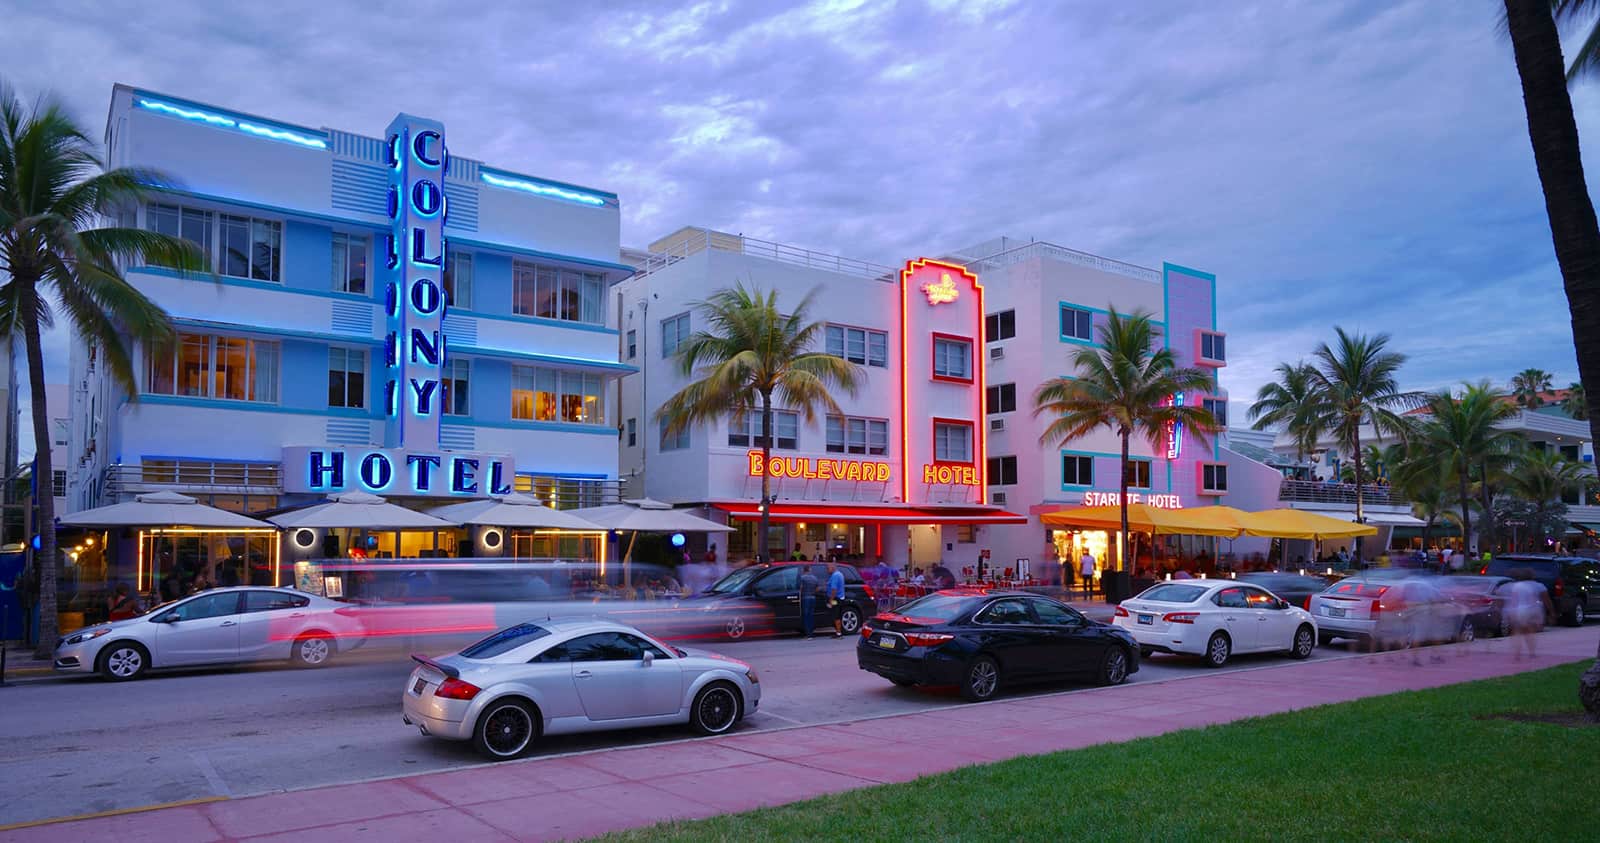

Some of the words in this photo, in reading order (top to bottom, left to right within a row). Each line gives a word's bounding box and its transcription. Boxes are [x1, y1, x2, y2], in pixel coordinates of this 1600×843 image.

[410, 130, 441, 415] COLONY
[310, 451, 511, 495] HOTEL
[748, 450, 891, 482] BOULEVARD
[923, 463, 981, 486] HOTEL
[1084, 491, 1141, 507] STARLTE
[1147, 494, 1183, 510] HOTEL
